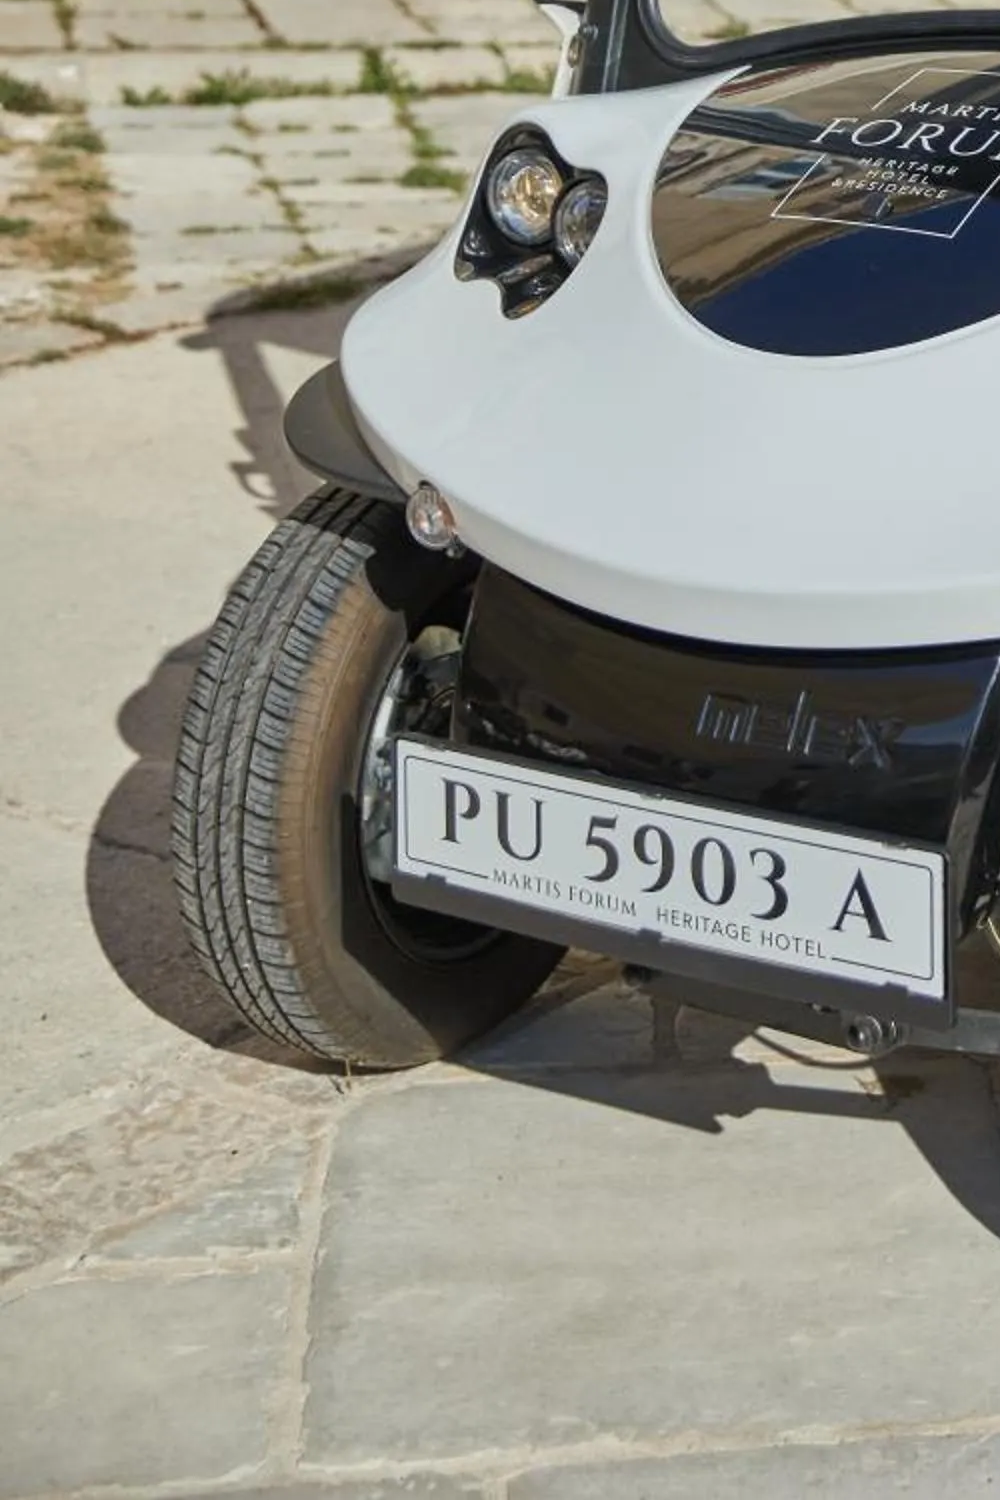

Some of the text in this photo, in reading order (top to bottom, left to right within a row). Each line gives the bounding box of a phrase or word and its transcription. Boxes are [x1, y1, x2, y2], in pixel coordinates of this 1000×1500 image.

[865, 169, 930, 185] HOTEL
[440, 777, 893, 943] PU 5903 A
[492, 868, 827, 959] MARTIS FORUM HERITAGE HOTEL
